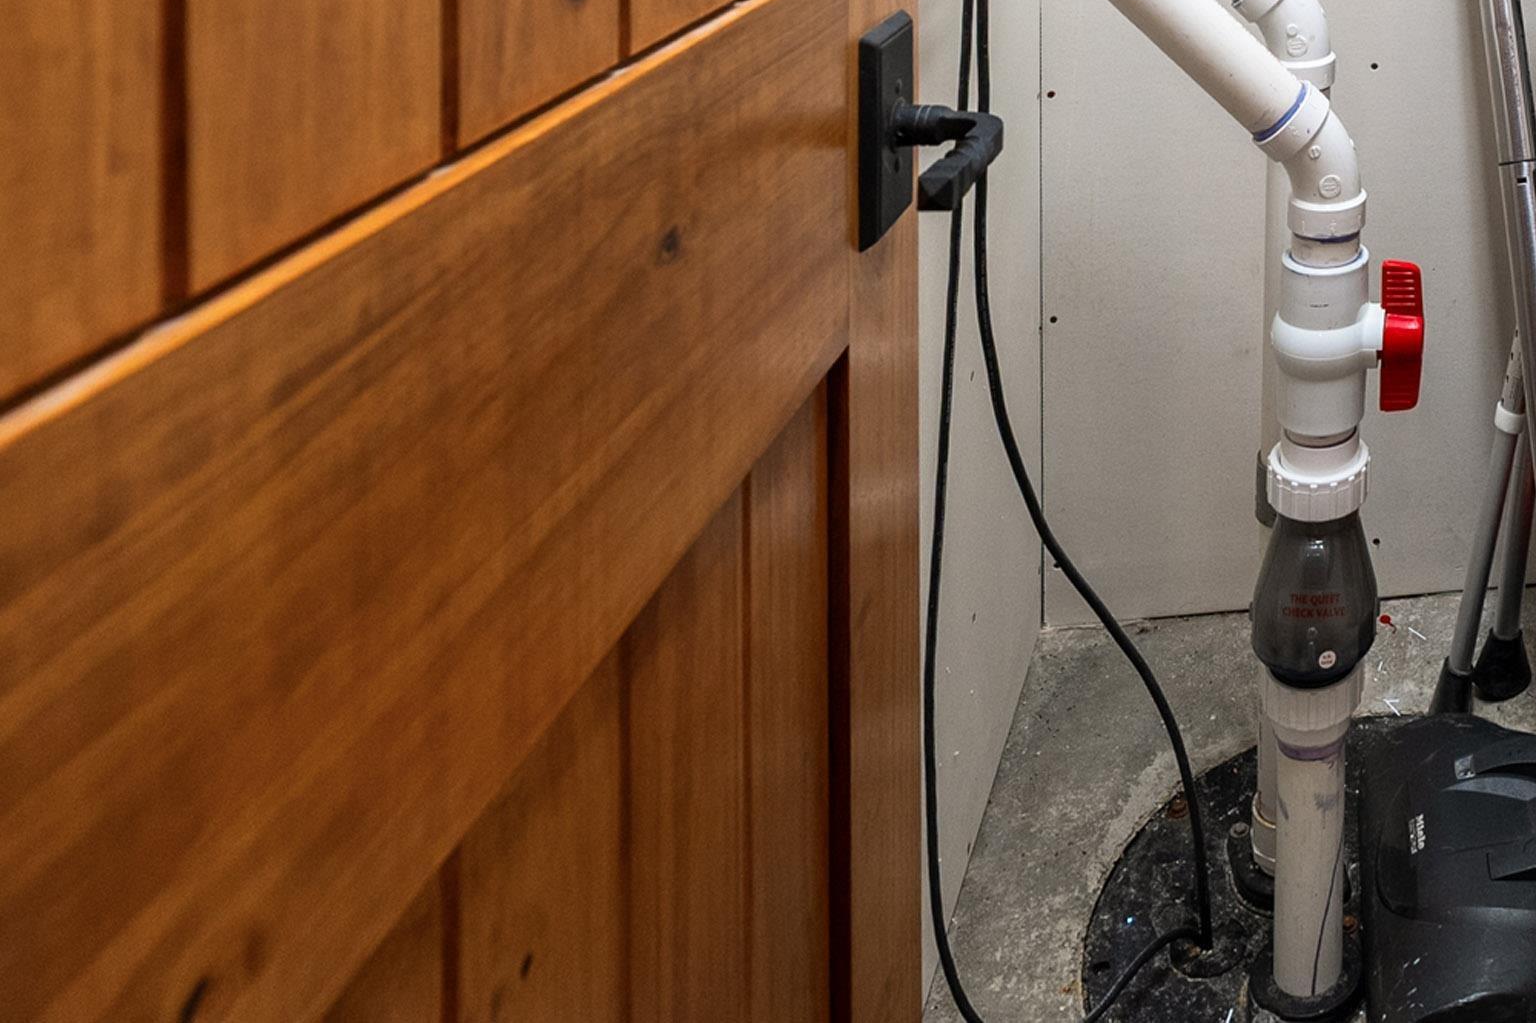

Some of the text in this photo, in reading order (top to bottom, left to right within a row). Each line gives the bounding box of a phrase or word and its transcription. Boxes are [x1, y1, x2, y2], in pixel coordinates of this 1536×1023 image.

[1291, 591, 1341, 606] THE QUIET
[1282, 607, 1345, 618] CHECK VALVE
[1416, 814, 1426, 850] Miele
